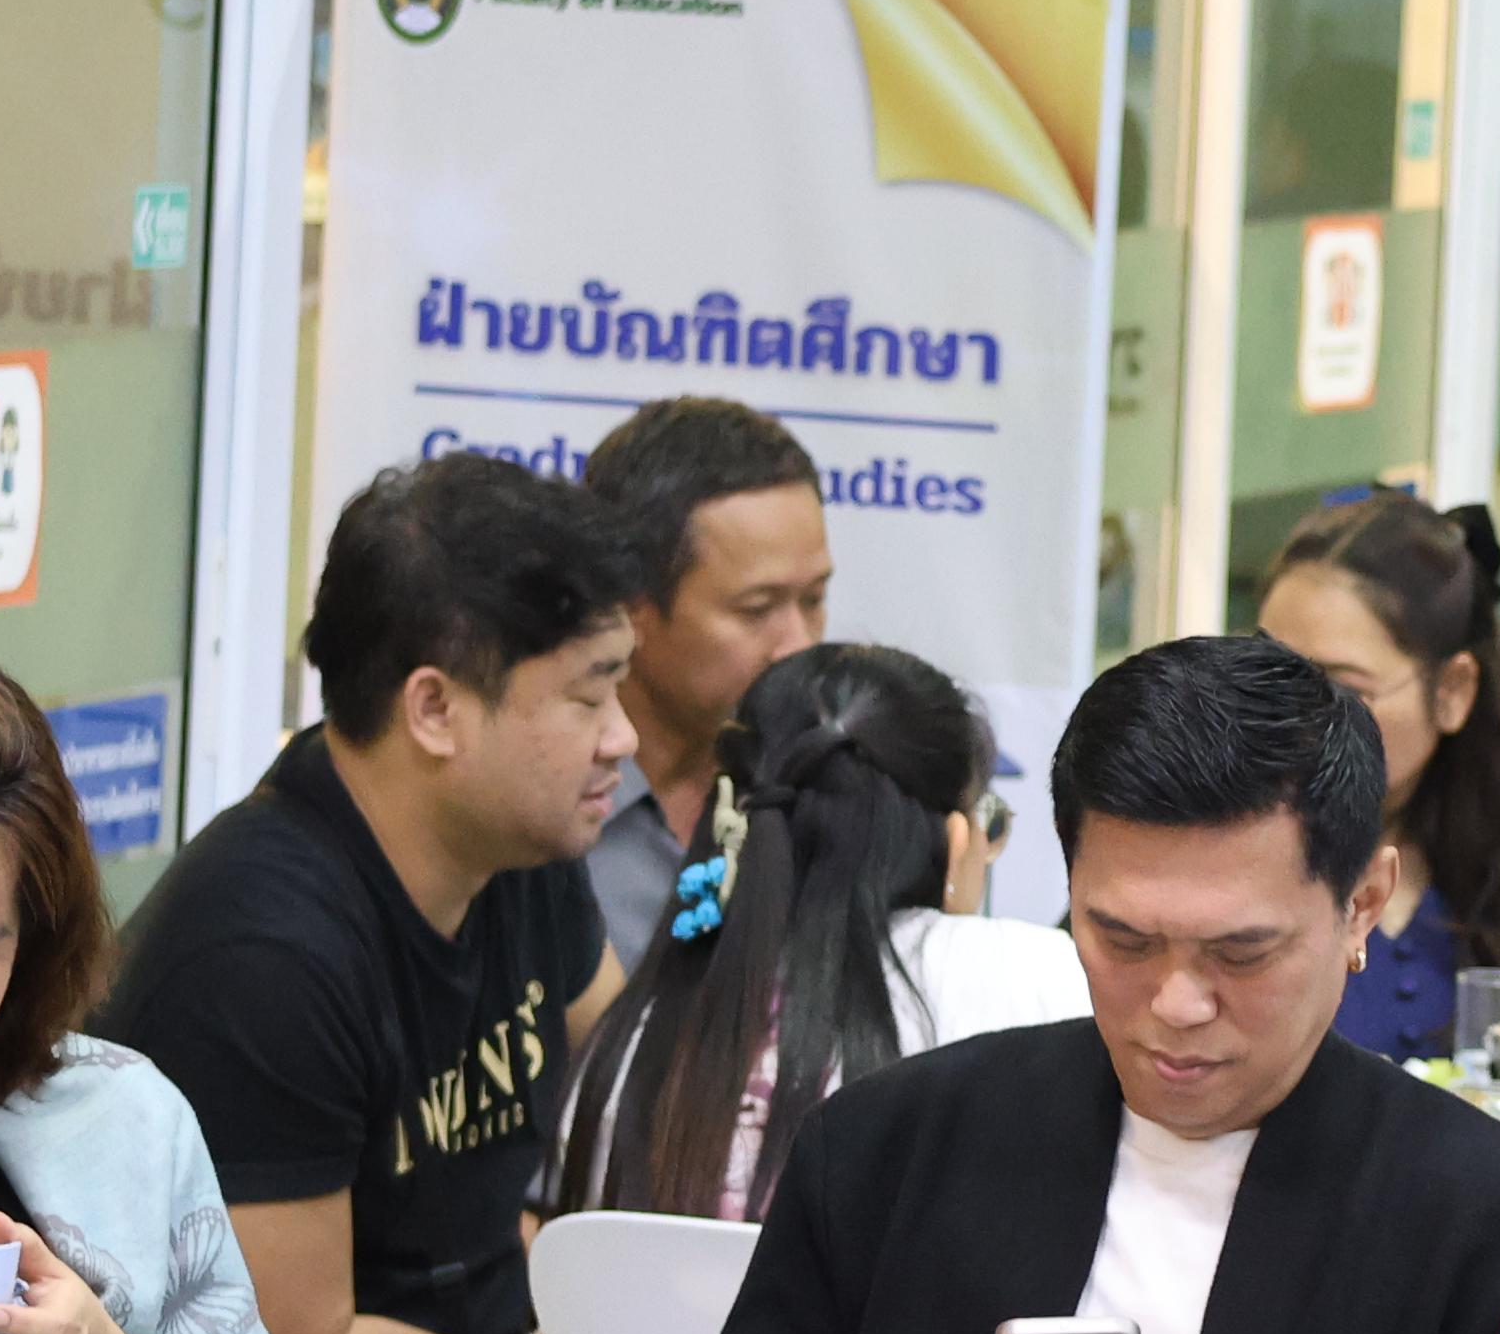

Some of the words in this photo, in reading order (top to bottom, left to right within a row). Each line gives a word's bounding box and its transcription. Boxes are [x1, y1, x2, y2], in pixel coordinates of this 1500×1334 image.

[417, 277, 1000, 384] ฝ่ายบัณฑิตศึกษา
